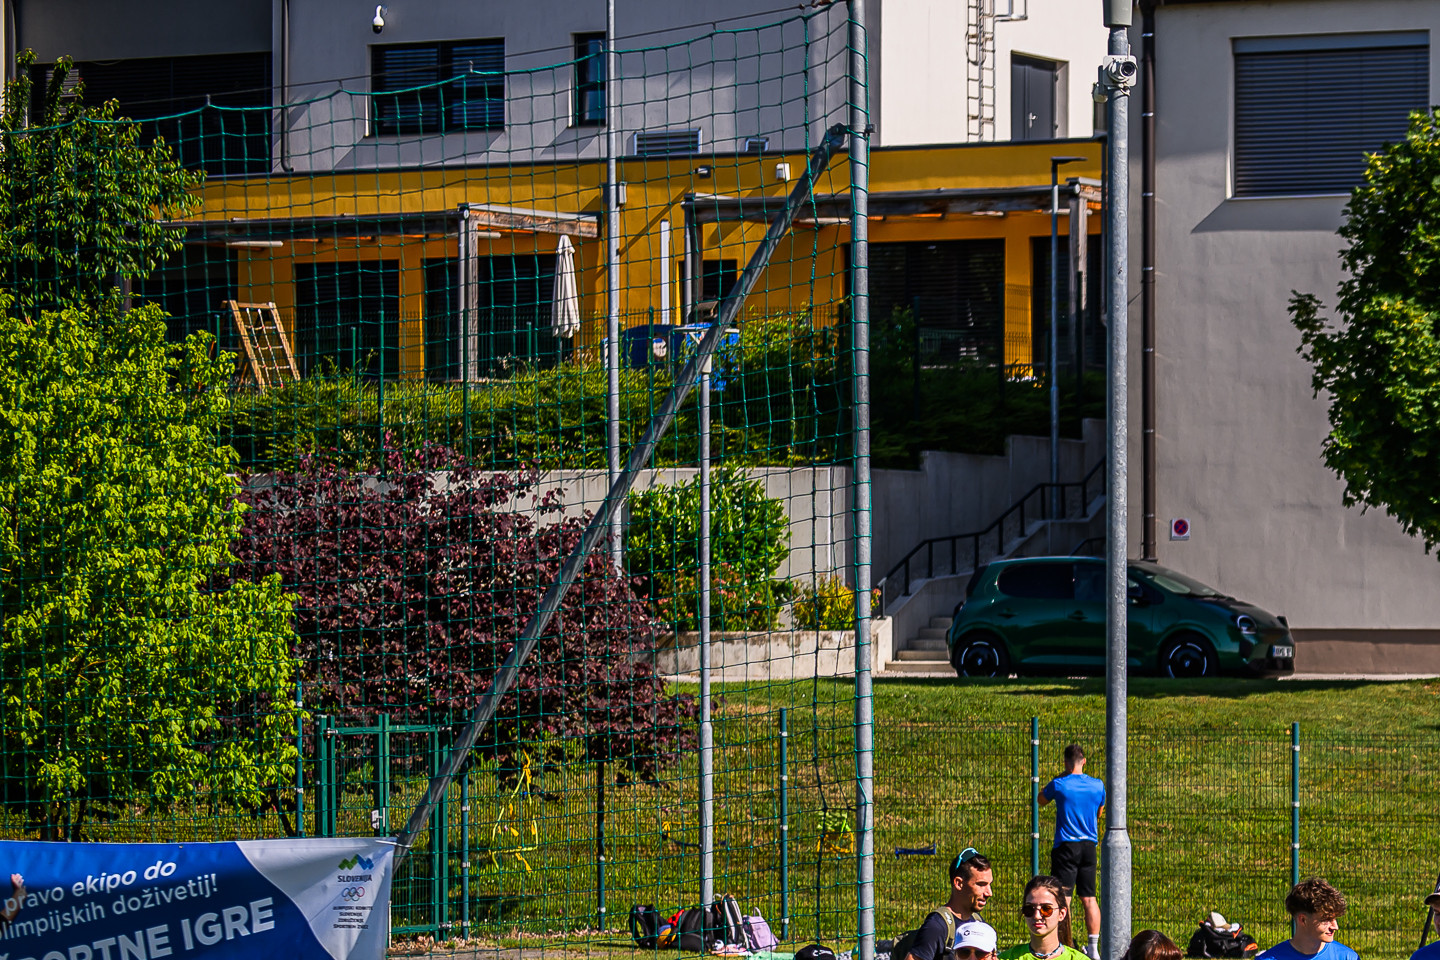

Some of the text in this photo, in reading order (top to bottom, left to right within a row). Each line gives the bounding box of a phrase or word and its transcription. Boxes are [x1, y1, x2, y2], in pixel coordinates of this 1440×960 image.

[0, 873, 218, 941] limpijskih doživetij!
[3, 860, 177, 916] pravo ekipo do
[182, 897, 275, 950] IGRE
